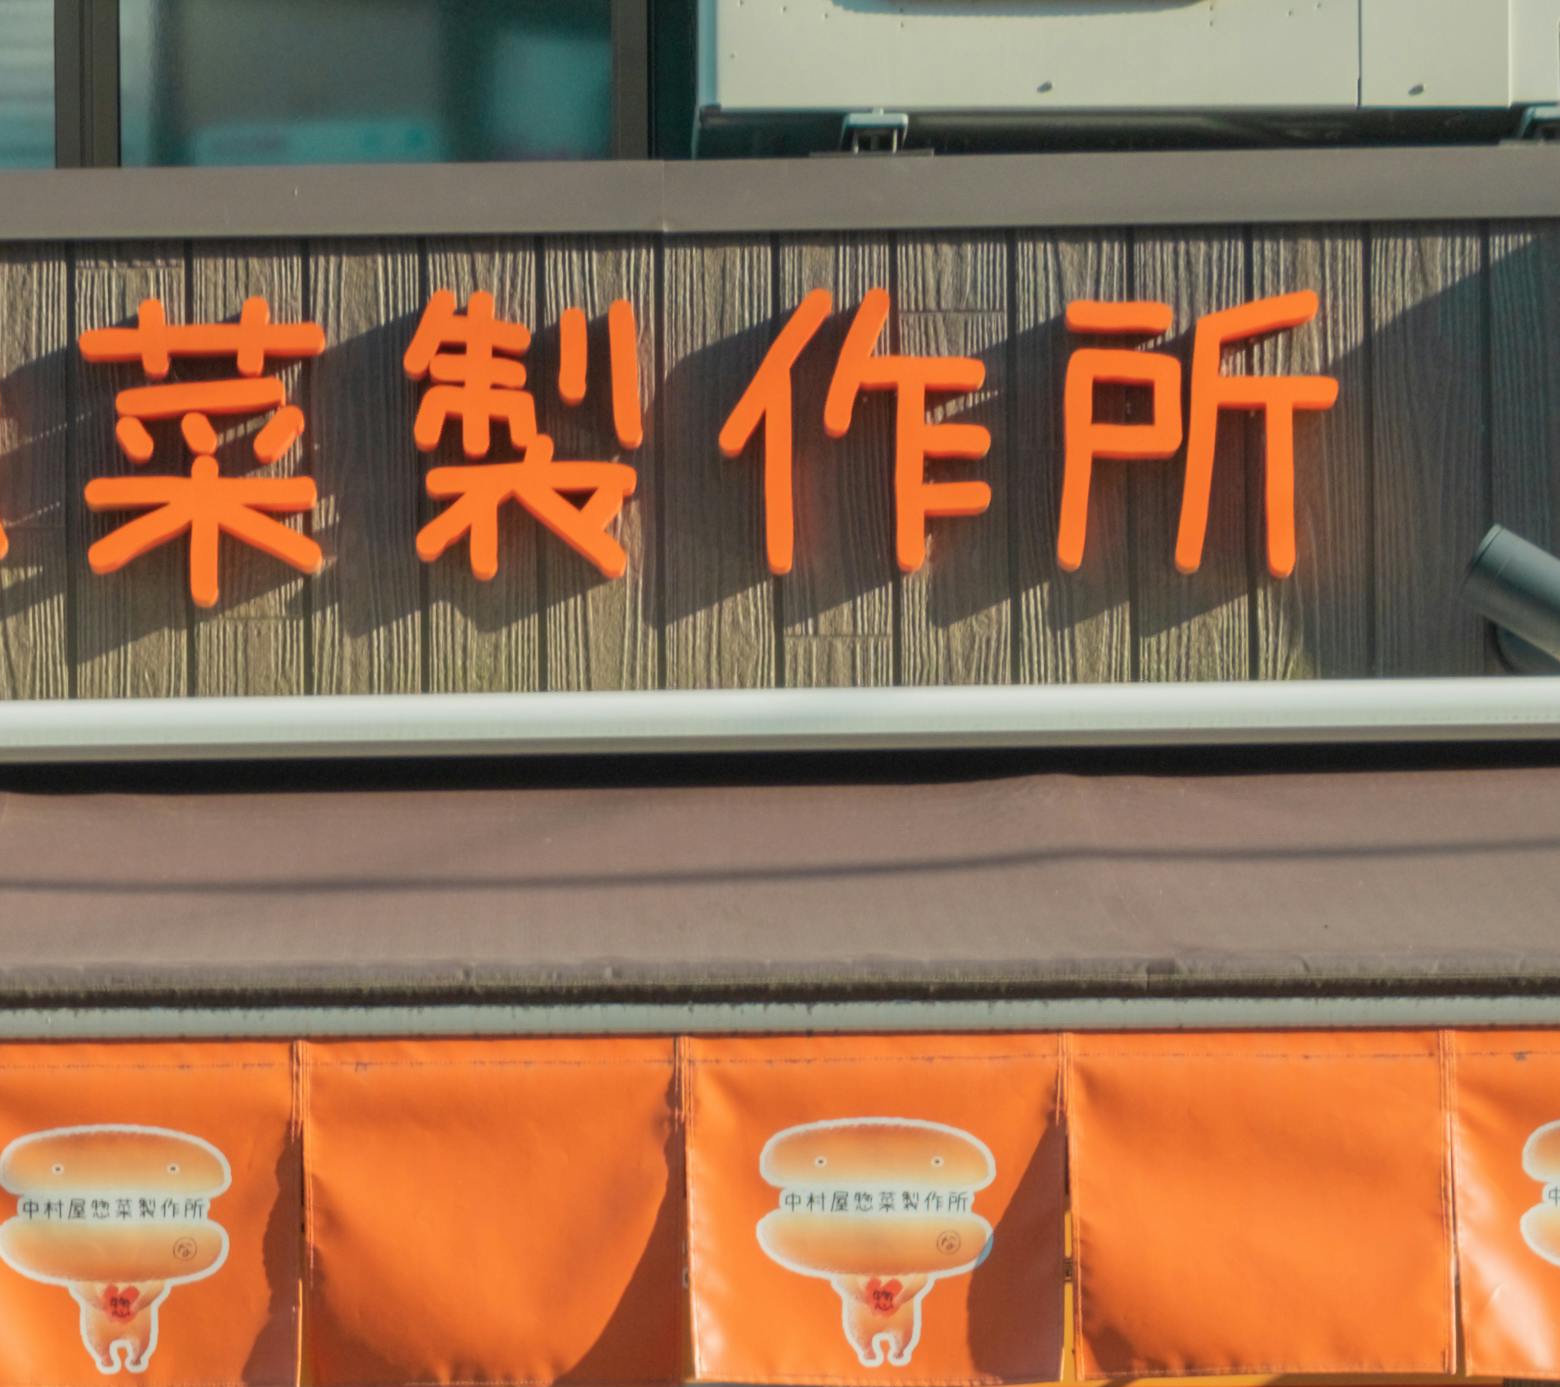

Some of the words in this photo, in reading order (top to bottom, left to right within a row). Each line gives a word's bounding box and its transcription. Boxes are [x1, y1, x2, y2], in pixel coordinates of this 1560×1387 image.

[19, 1196, 207, 1222] 中村屋惣菜製作所
[781, 1188, 971, 1214] 中村屋惣菜製作所
